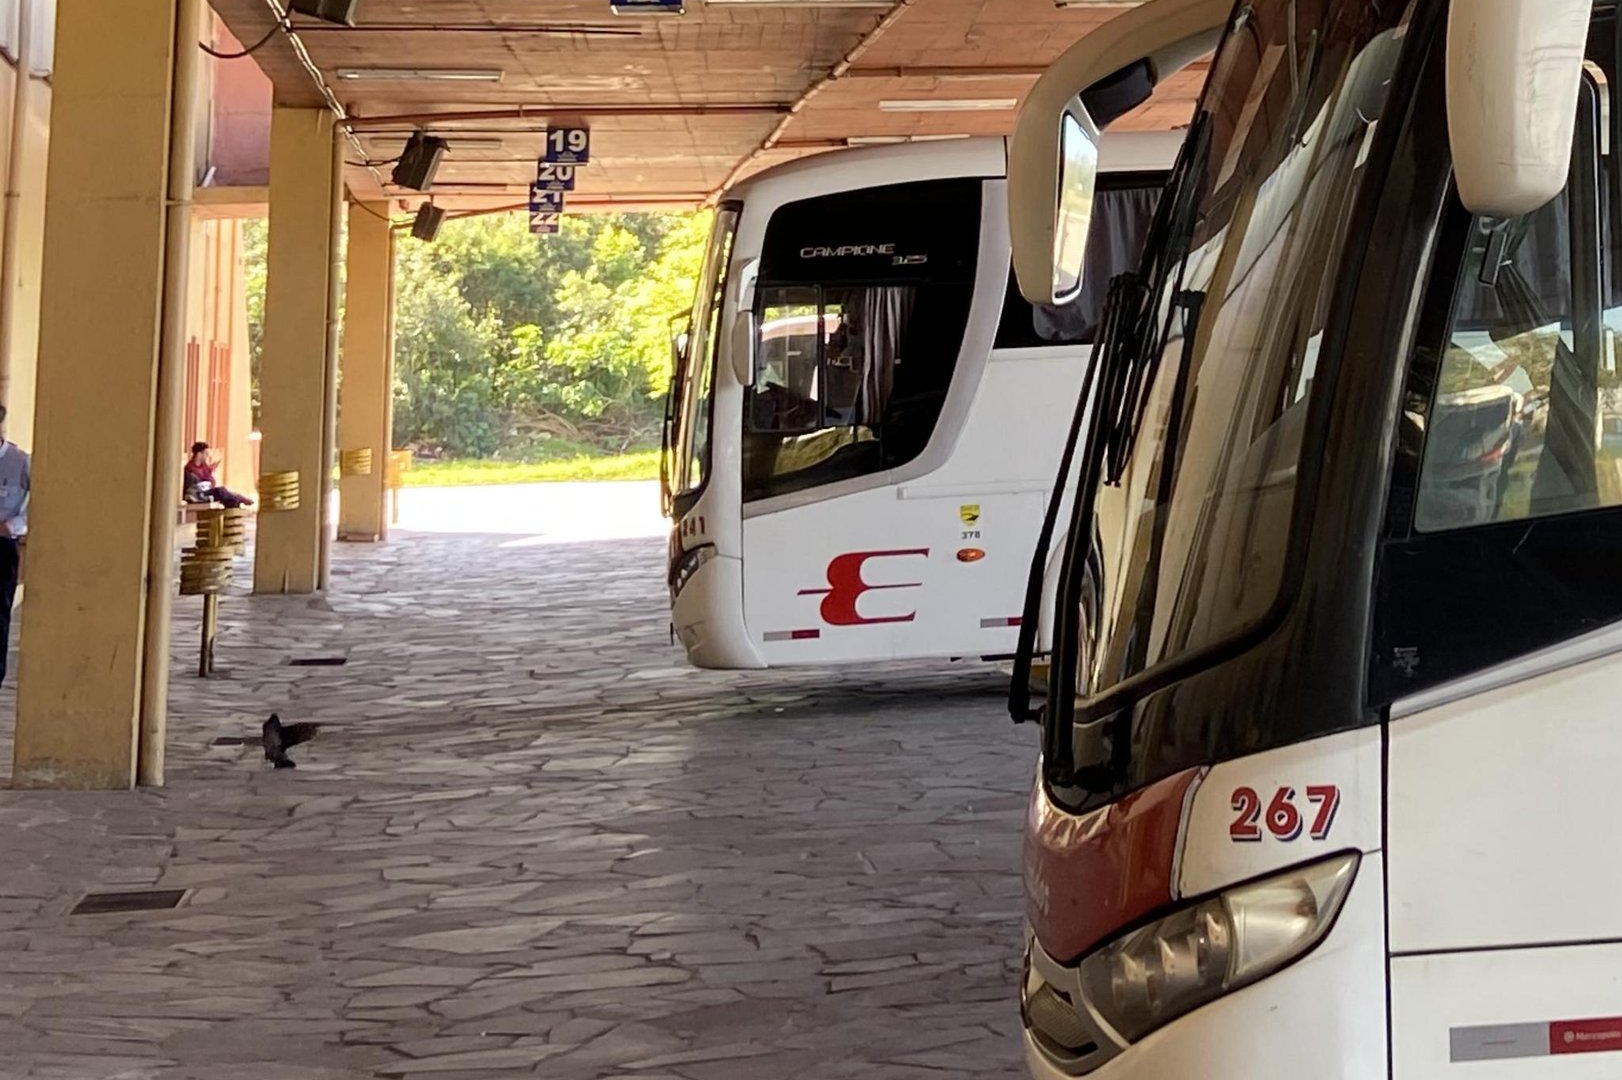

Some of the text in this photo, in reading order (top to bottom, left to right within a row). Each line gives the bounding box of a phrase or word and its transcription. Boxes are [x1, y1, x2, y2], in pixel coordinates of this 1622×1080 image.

[550, 129, 587, 152] 19
[538, 161, 574, 181] 20
[799, 242, 897, 259] CAMPIONE
[1228, 784, 1341, 842] 267
